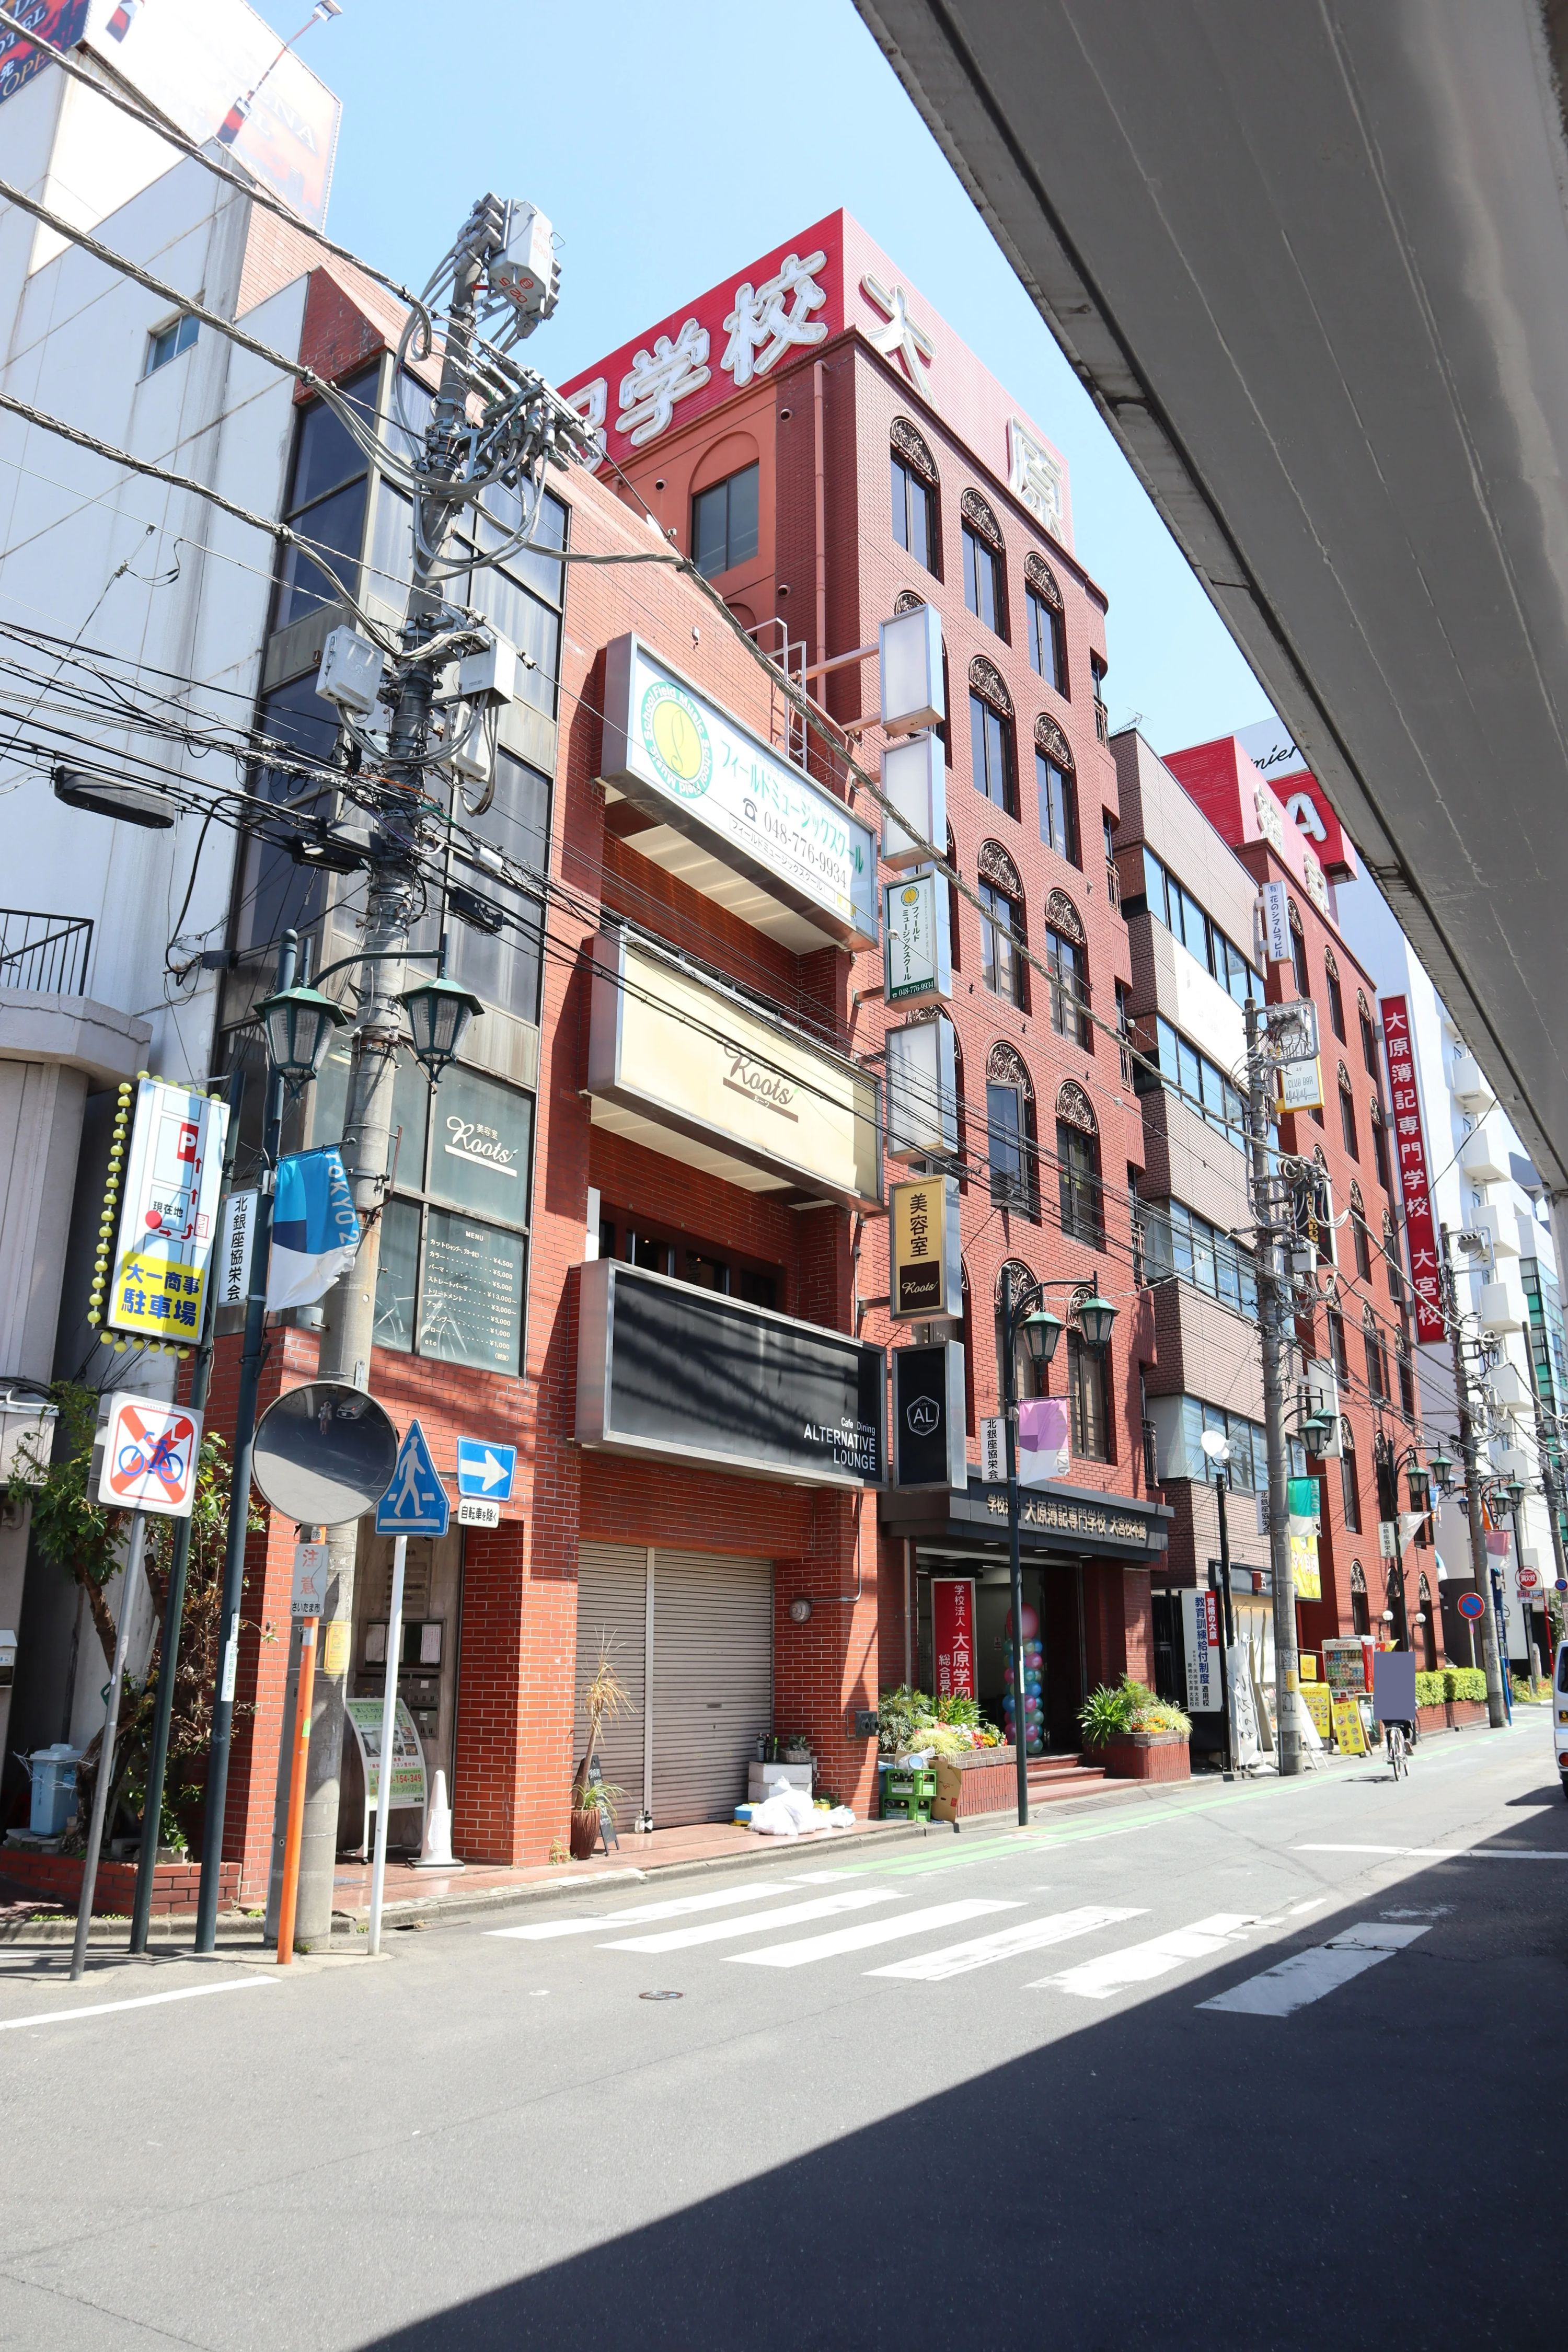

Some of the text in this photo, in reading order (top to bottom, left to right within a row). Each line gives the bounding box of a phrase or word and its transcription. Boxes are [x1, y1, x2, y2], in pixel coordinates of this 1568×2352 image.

[720, 740, 864, 876] フィールドミュージックスクール
[732, 818, 822, 891] フィールドミュージックスクール
[764, 811, 847, 889] 048-776-9934
[902, 909, 912, 982] ミュージックスクール
[898, 981, 934, 997] 048-776-9934
[1288, 1076, 1313, 1089] CLUB BAR
[754, 1095, 769, 1108] ルーツ
[179, 1130, 197, 1154] P
[446, 1116, 515, 1163] Roots
[476, 1123, 499, 1140] 美容室
[1385, 1011, 1443, 1328] 大原簿記専門学校 大宮校
[326, 1151, 356, 1225] TOKYO
[153, 1201, 183, 1218] 現在地
[465, 1230, 483, 1242] MENU
[909, 1192, 929, 1258] 美容室
[227, 1196, 248, 1301] 北銀座協栄会
[429, 1250, 513, 1281] カラー ¥5,000
[493, 1257, 513, 1269] ¥4,500
[126, 1263, 200, 1295] 大一商事
[427, 1275, 468, 1292] ストレートパーマ
[428, 1263, 512, 1293] パーマ ¥5,000
[902, 1281, 938, 1295] Roots
[121, 1287, 197, 1327] 駐車場
[428, 1287, 463, 1302] トリートメント
[425, 1312, 510, 1339] シャンプー ¥1,000
[426, 1300, 511, 1327] アップ ¥5,000
[424, 1339, 437, 1347] etc
[489, 1339, 510, 1350] ¥1,000
[841, 1417, 875, 1436] Cafe Dining
[913, 1407, 934, 1424] AL
[803, 1423, 875, 1452] ALTERNATIVE
[987, 1420, 998, 1480] 北銀座協栄会
[833, 1448, 876, 1471] LOUNGE
[461, 1505, 497, 1523] 自転車を除く
[1024, 1498, 1107, 1535] 大原簿記専門学校
[300, 1549, 319, 1595] 注意
[292, 1601, 320, 1613] さいたま市
[954, 1584, 966, 1627] 学校法人
[1206, 1597, 1218, 1640] 資格の大原
[1195, 1596, 1210, 1707] 教育訓練給付制度 適用校
